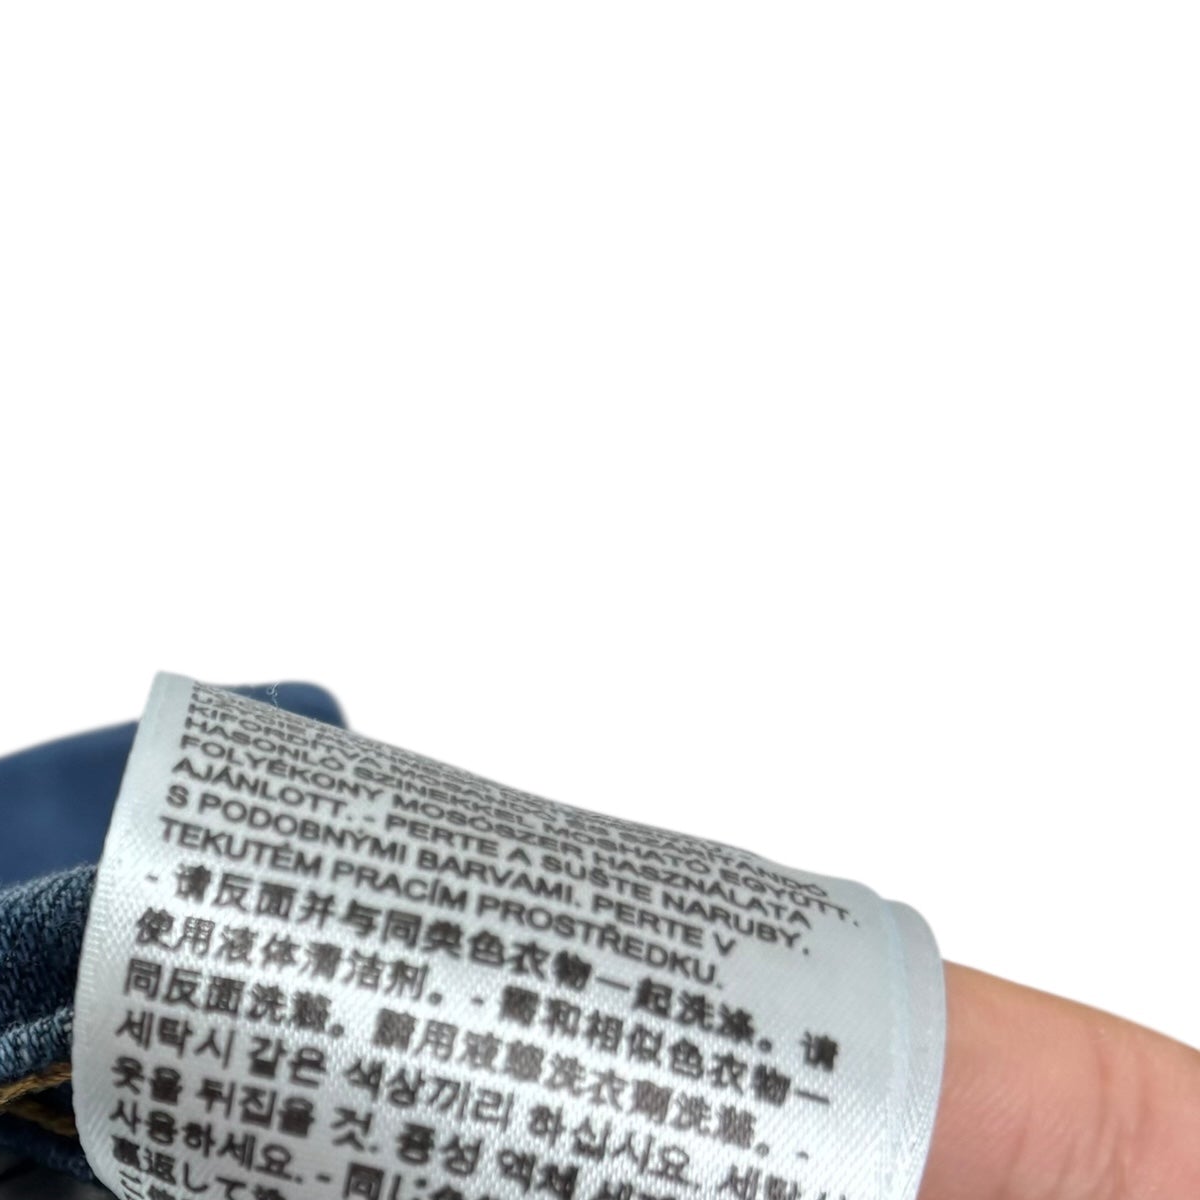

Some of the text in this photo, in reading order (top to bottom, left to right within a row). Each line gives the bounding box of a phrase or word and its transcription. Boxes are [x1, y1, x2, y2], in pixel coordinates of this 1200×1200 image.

[158, 814, 723, 989] TEKUTÉM PRACÍM PROSTŘEDKU.
[166, 784, 736, 957] S PODOBNÝMI BARVAMI. PERTE V
[385, 813, 500, 858] PERTE
[505, 846, 532, 867] A
[661, 890, 809, 957] NARUBY.
[111, 1055, 183, 1106] 옷을
[195, 1077, 316, 1139] 뒤집을
[330, 1106, 379, 1154] 것.
[115, 1008, 237, 1069] 세탁시
[249, 1034, 327, 1088] 같은
[343, 1055, 515, 1133] 색상끼리
[109, 1098, 303, 1185] 사용하세요.
